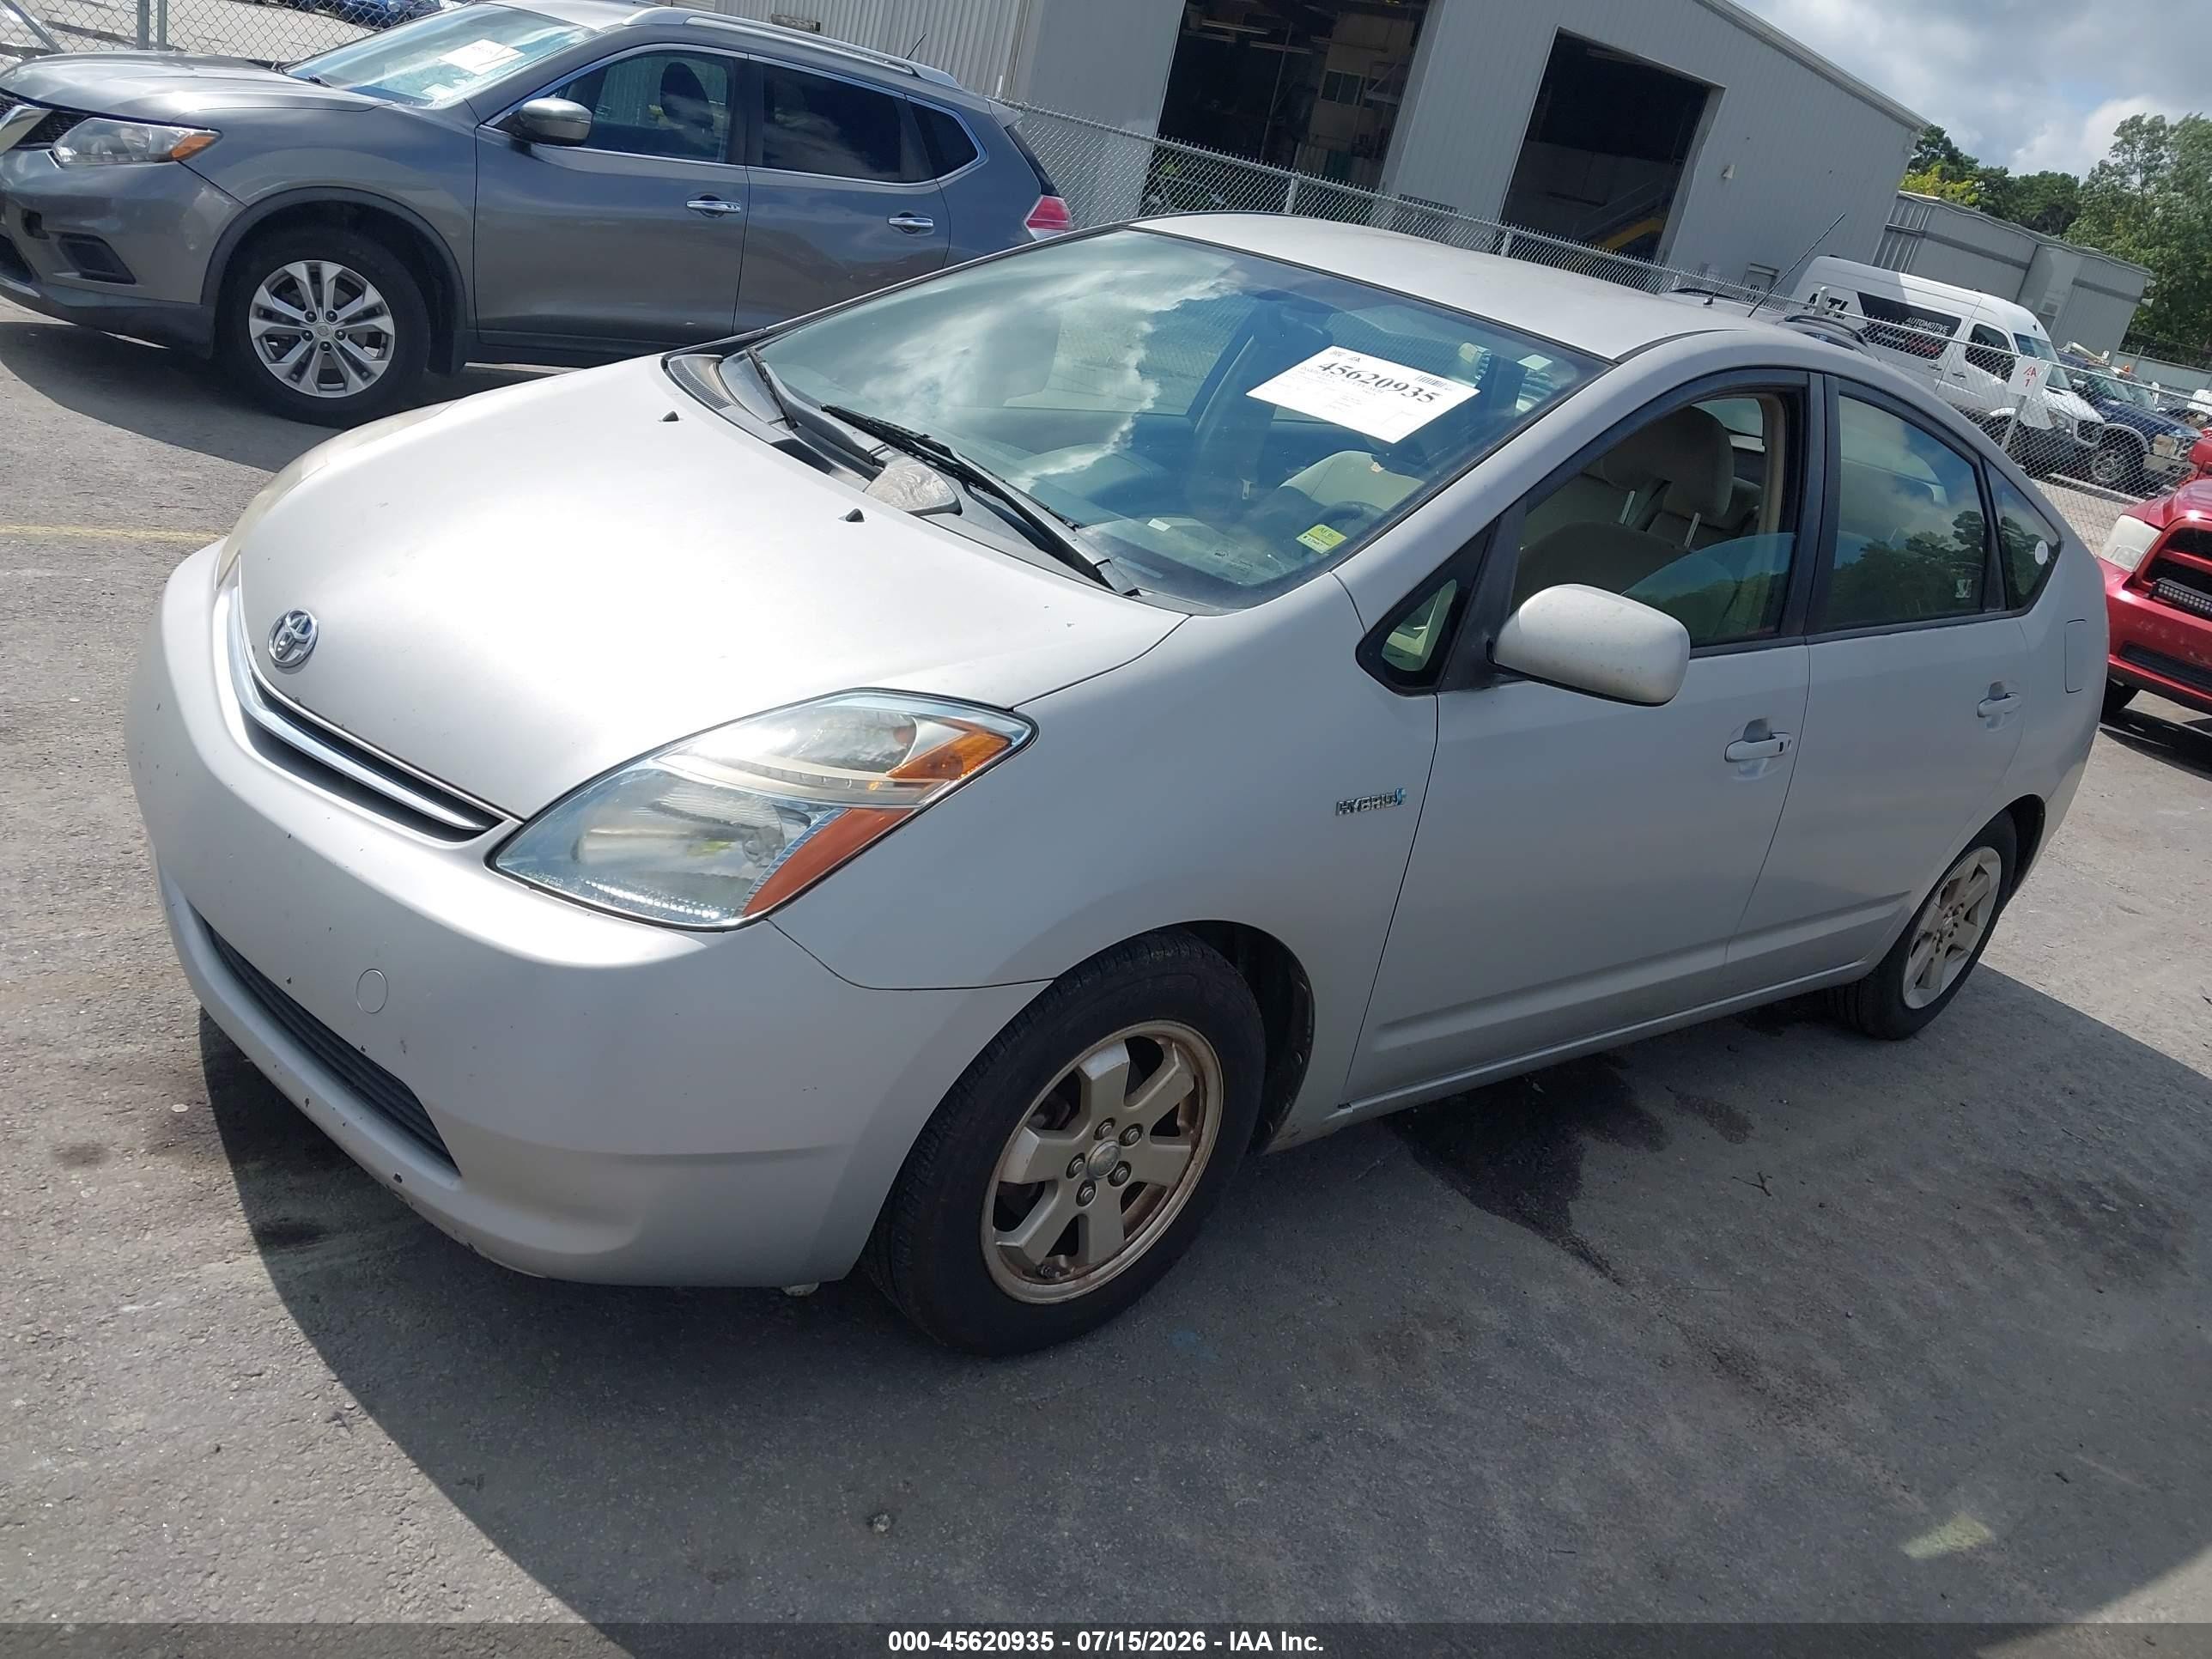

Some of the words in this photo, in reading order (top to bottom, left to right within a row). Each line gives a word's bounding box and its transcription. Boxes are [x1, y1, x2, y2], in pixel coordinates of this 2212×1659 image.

[1905, 316, 1951, 333] AUTOMOTIVE
[1318, 362, 1443, 403] 45620935
[1335, 793, 1397, 816] HYBRID
